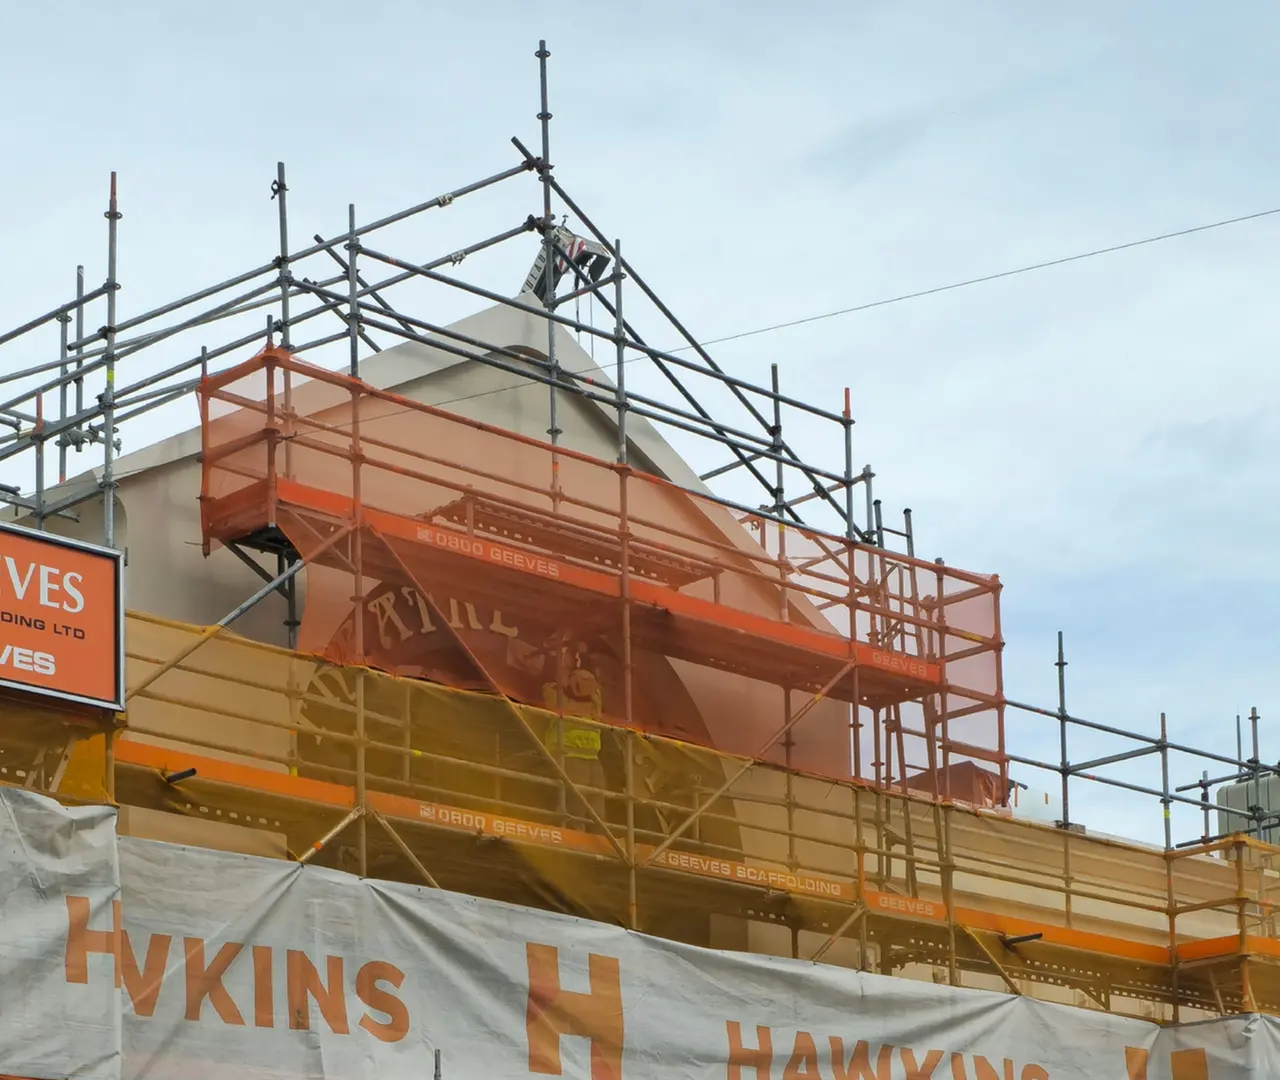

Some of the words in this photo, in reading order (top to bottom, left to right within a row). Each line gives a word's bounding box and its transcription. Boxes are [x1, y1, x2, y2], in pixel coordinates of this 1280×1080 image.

[434, 530, 484, 558] 0800
[489, 542, 560, 578] GEEVES
[53, 623, 86, 640] LTD
[437, 806, 486, 831] 0800
[491, 817, 563, 845] GEEVES
[666, 850, 731, 876] GEEVES
[735, 864, 842, 897] SCAFFOLDING
[878, 895, 935, 917] GEEVES
